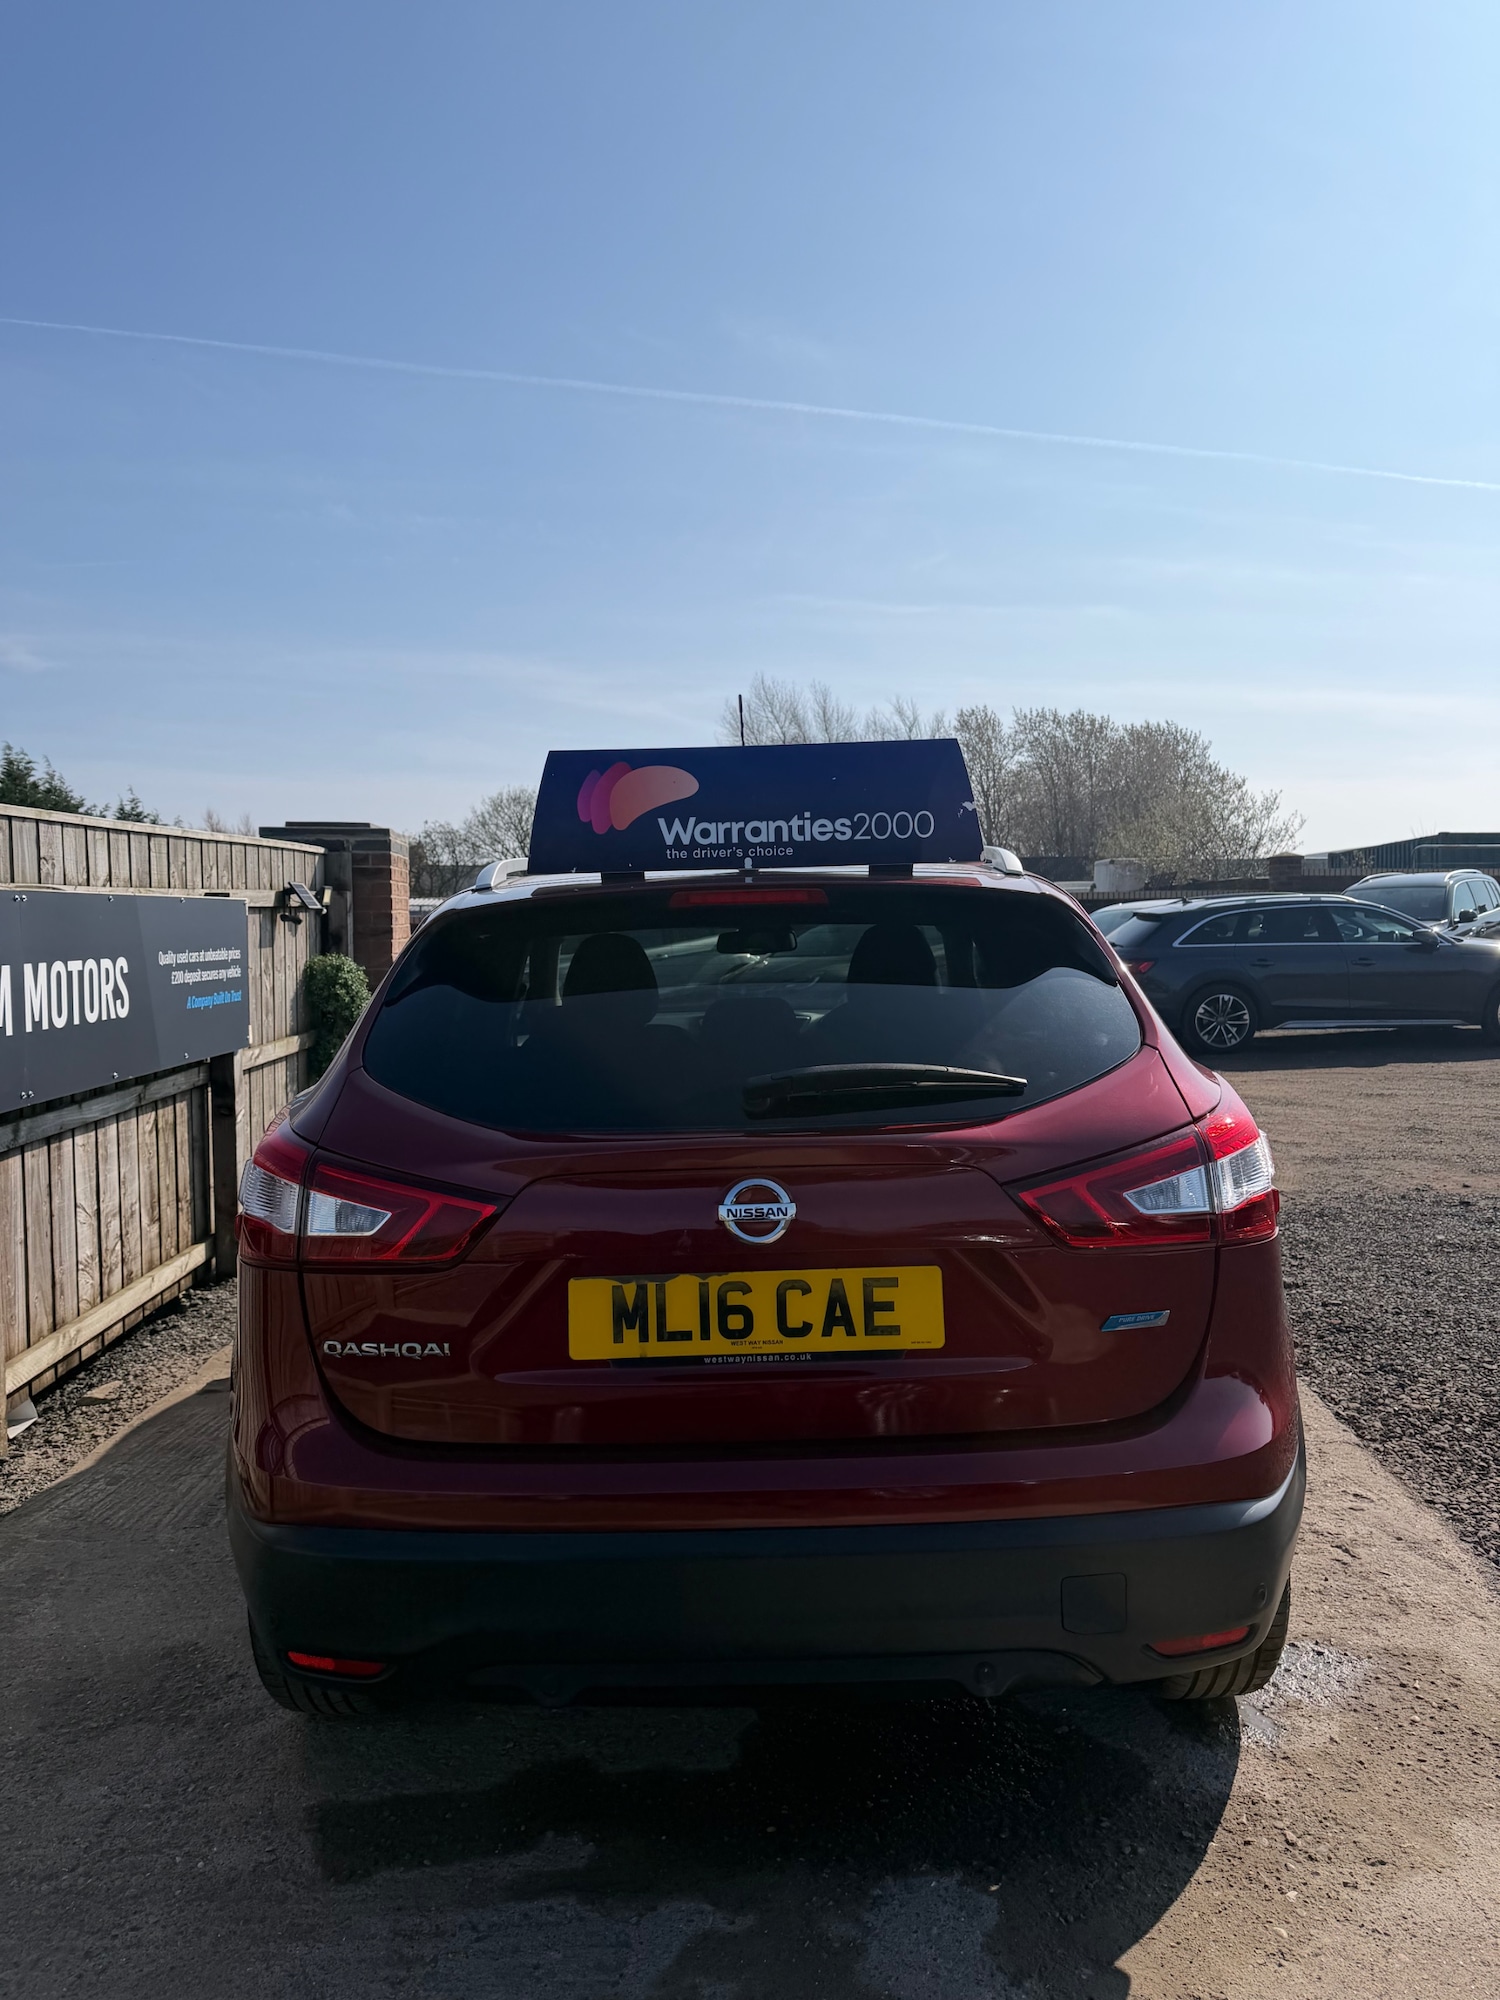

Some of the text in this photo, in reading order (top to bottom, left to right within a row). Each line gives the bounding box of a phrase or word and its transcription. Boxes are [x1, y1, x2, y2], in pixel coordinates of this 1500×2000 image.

[666, 845, 794, 859] the driver's choice
[158, 946, 242, 967] Quality used cars at unbeatable prices
[184, 968, 201, 986] deposit
[201, 969, 219, 981] secures
[219, 969, 227, 982] any
[227, 965, 242, 979] vehicle
[23, 956, 130, 1033] MOTORS
[186, 996, 192, 1010] A
[192, 995, 213, 1010] Company
[213, 992, 225, 1006] Built
[231, 989, 242, 1003] Trust
[726, 1206, 788, 1218] NISSAN
[611, 1276, 901, 1344] ML16 CAE
[323, 1340, 451, 1360] QASHQAI
[703, 1352, 812, 1365] westwaynissan.co.uk
